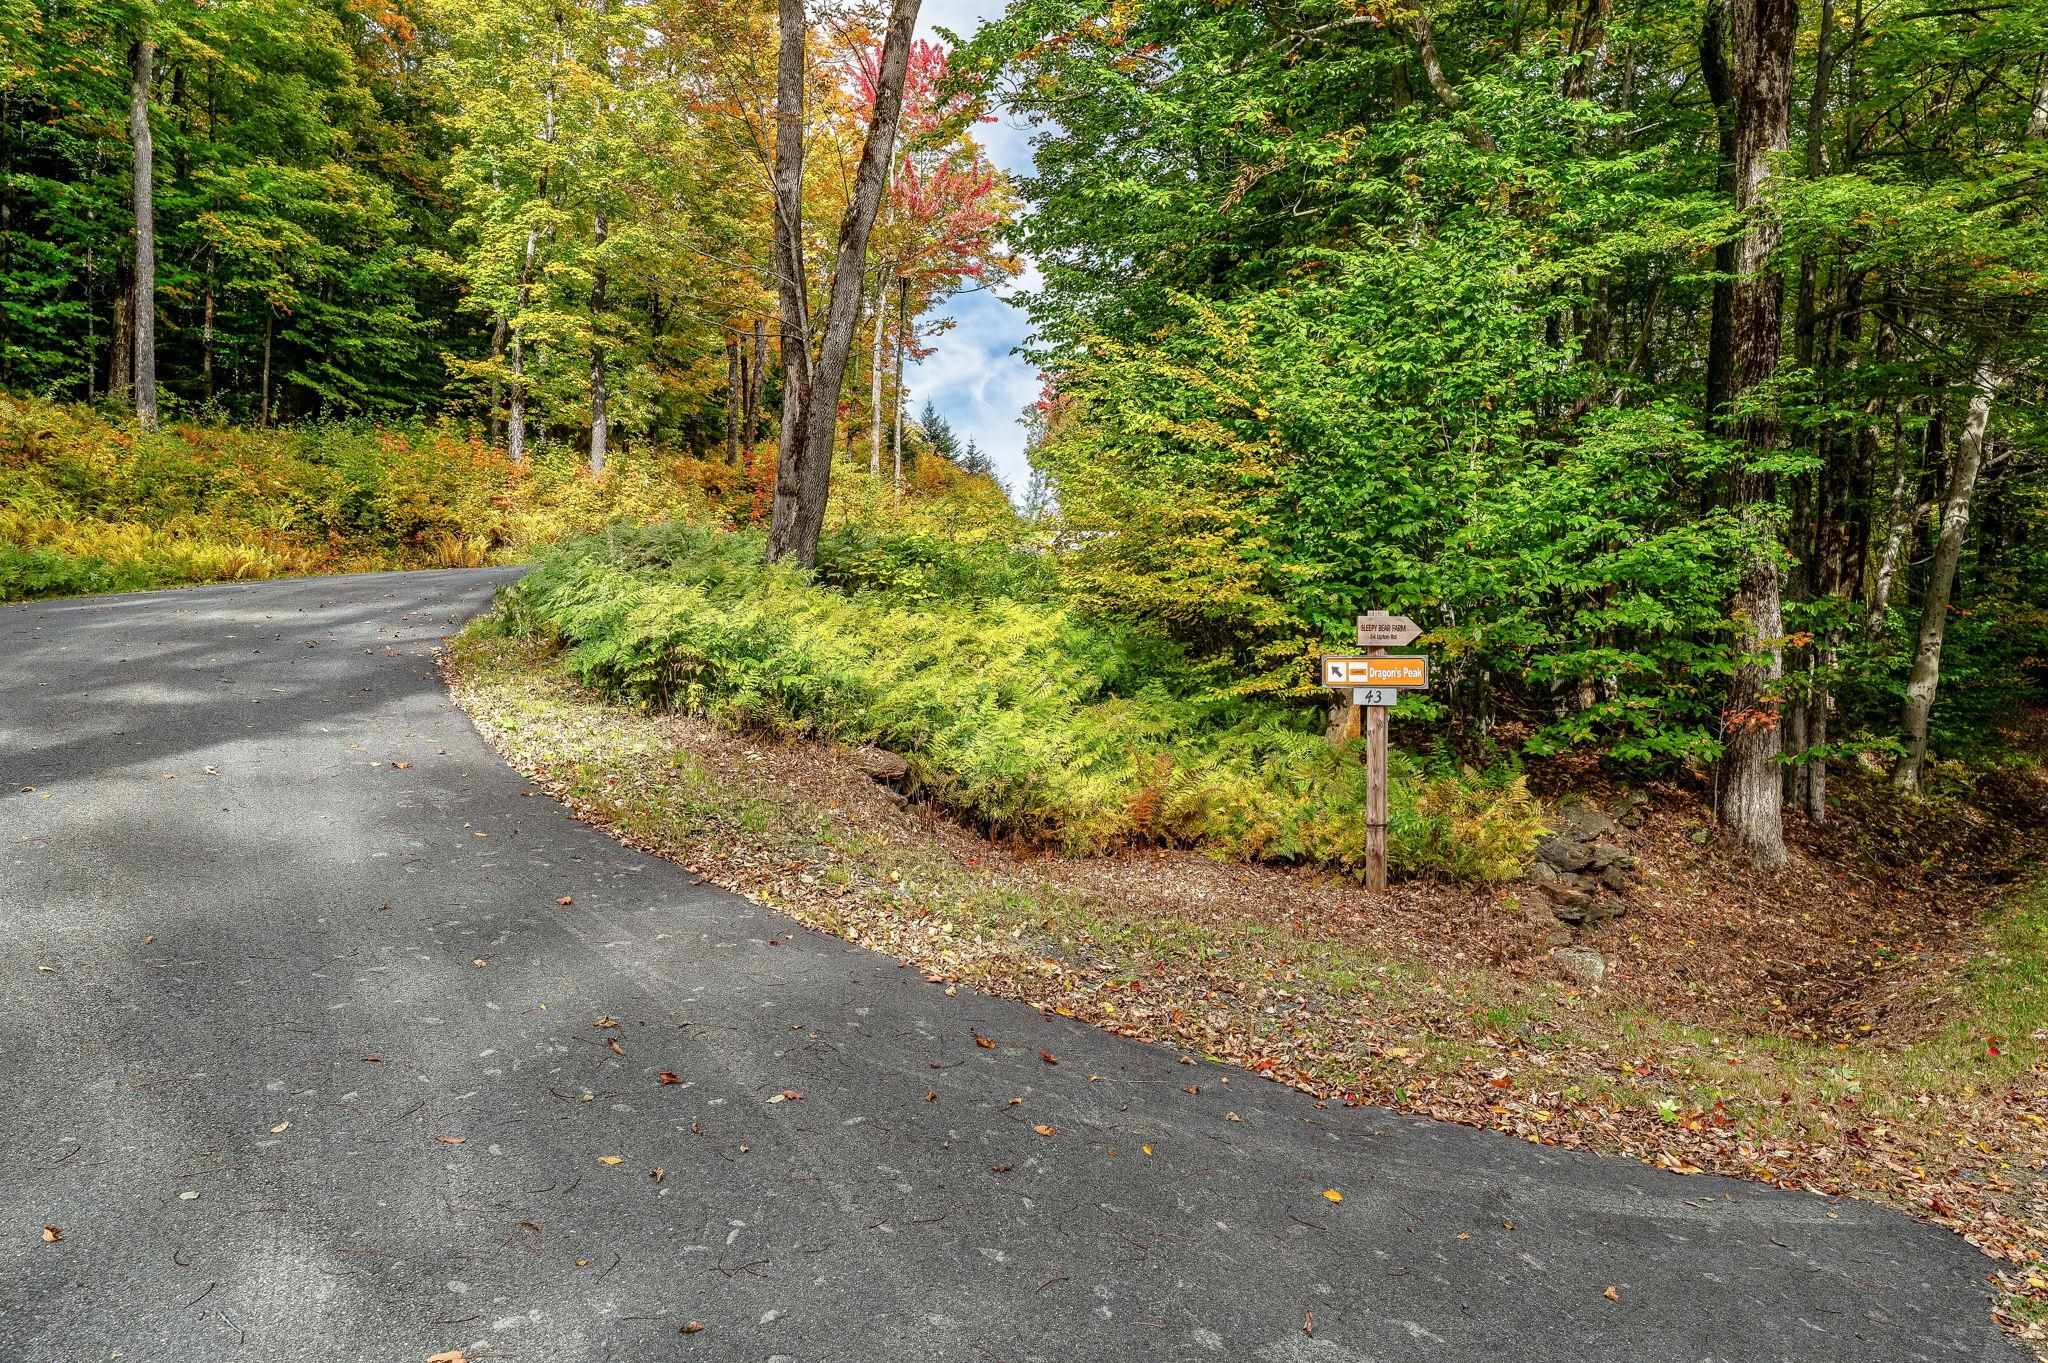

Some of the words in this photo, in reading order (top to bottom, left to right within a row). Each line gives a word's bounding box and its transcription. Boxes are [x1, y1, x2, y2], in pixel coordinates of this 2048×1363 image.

[1360, 624, 1378, 632] SLEEPY
[1378, 624, 1391, 632] BEAR
[1392, 624, 1407, 632] FARM
[1370, 667, 1401, 680] Dragon's
[1403, 667, 1422, 678] Peak
[1365, 690, 1382, 704] 43
